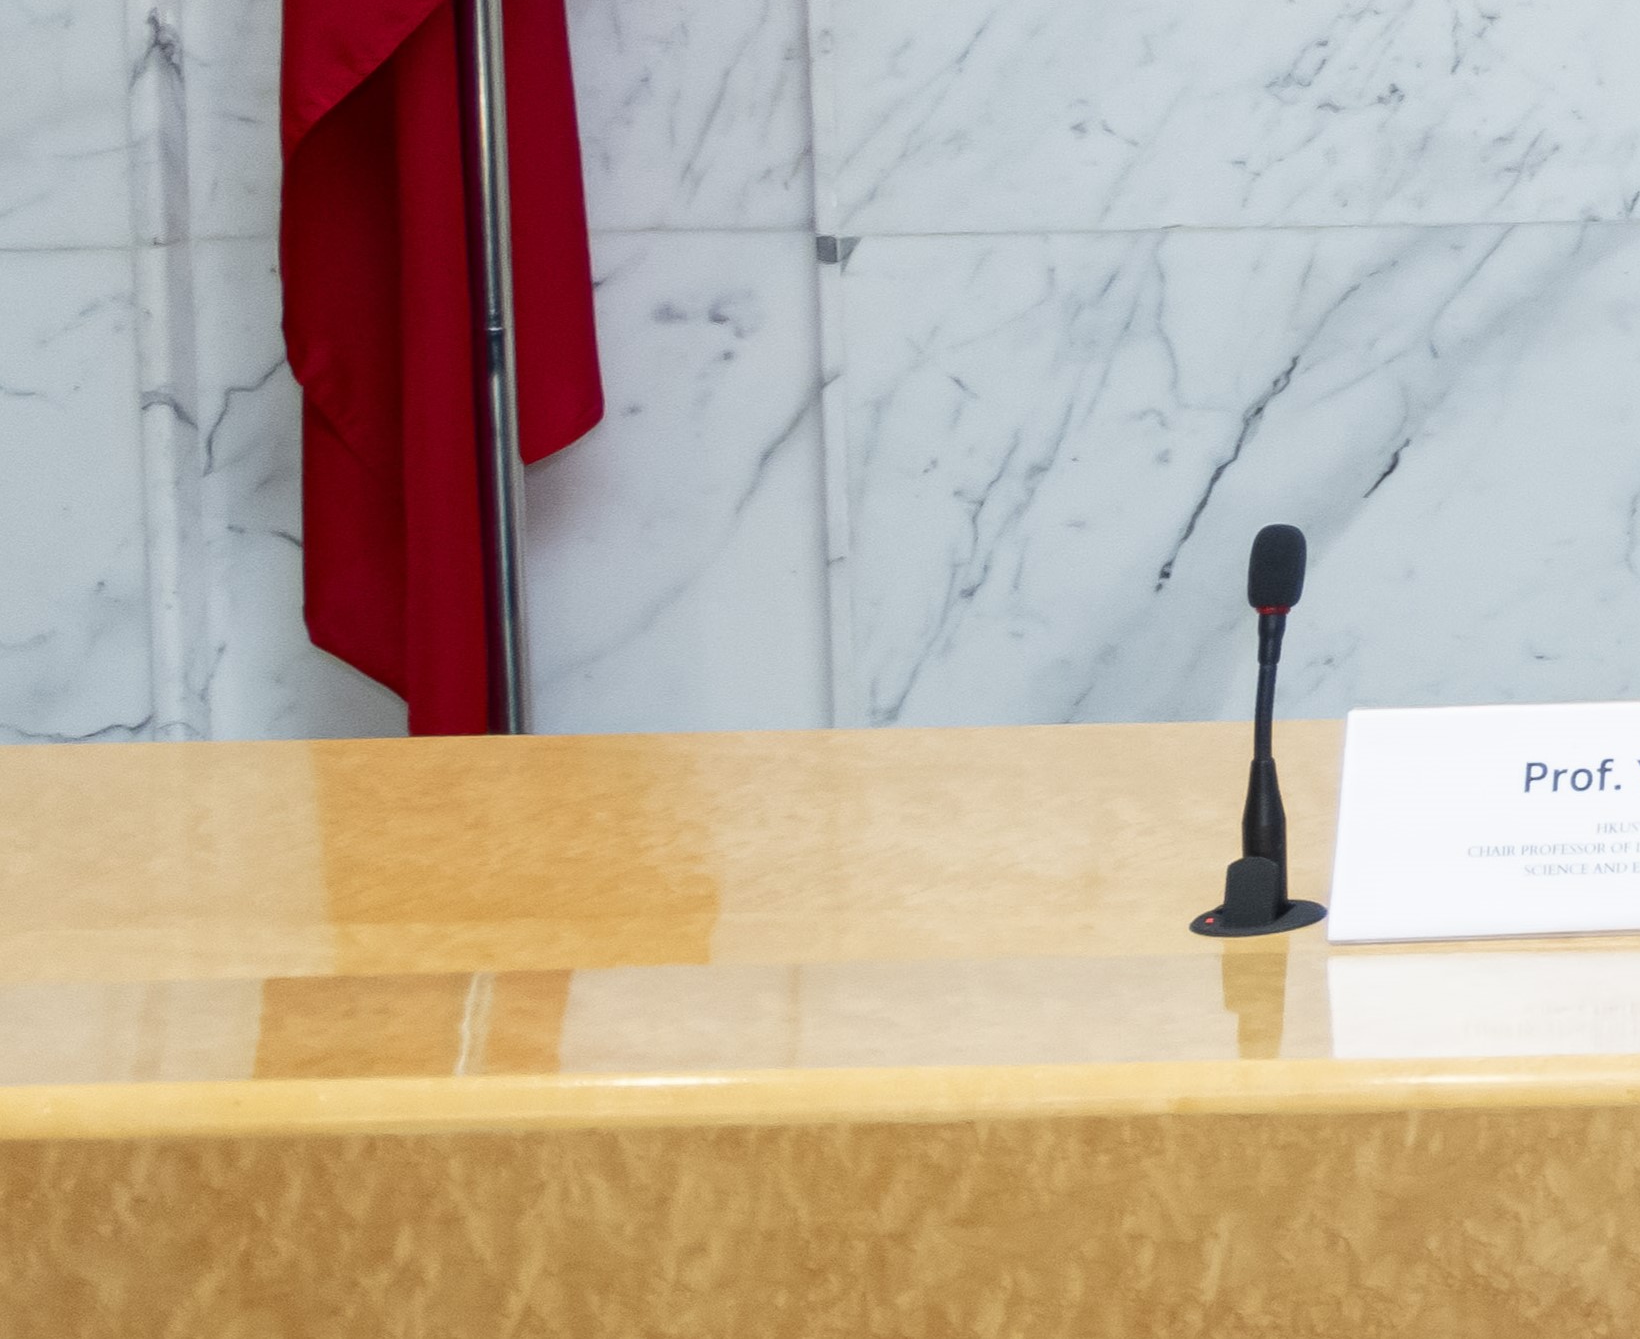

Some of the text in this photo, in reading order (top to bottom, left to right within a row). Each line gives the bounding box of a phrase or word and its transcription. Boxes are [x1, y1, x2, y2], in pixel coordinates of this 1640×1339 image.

[1524, 758, 1622, 793] Prof.
[1467, 843, 1516, 858] CHAIR
[1520, 841, 1606, 856] PROFESSOR
[1610, 841, 1631, 854] OF
[1524, 863, 1588, 876] SCIENCE
[1592, 862, 1628, 874] AND
